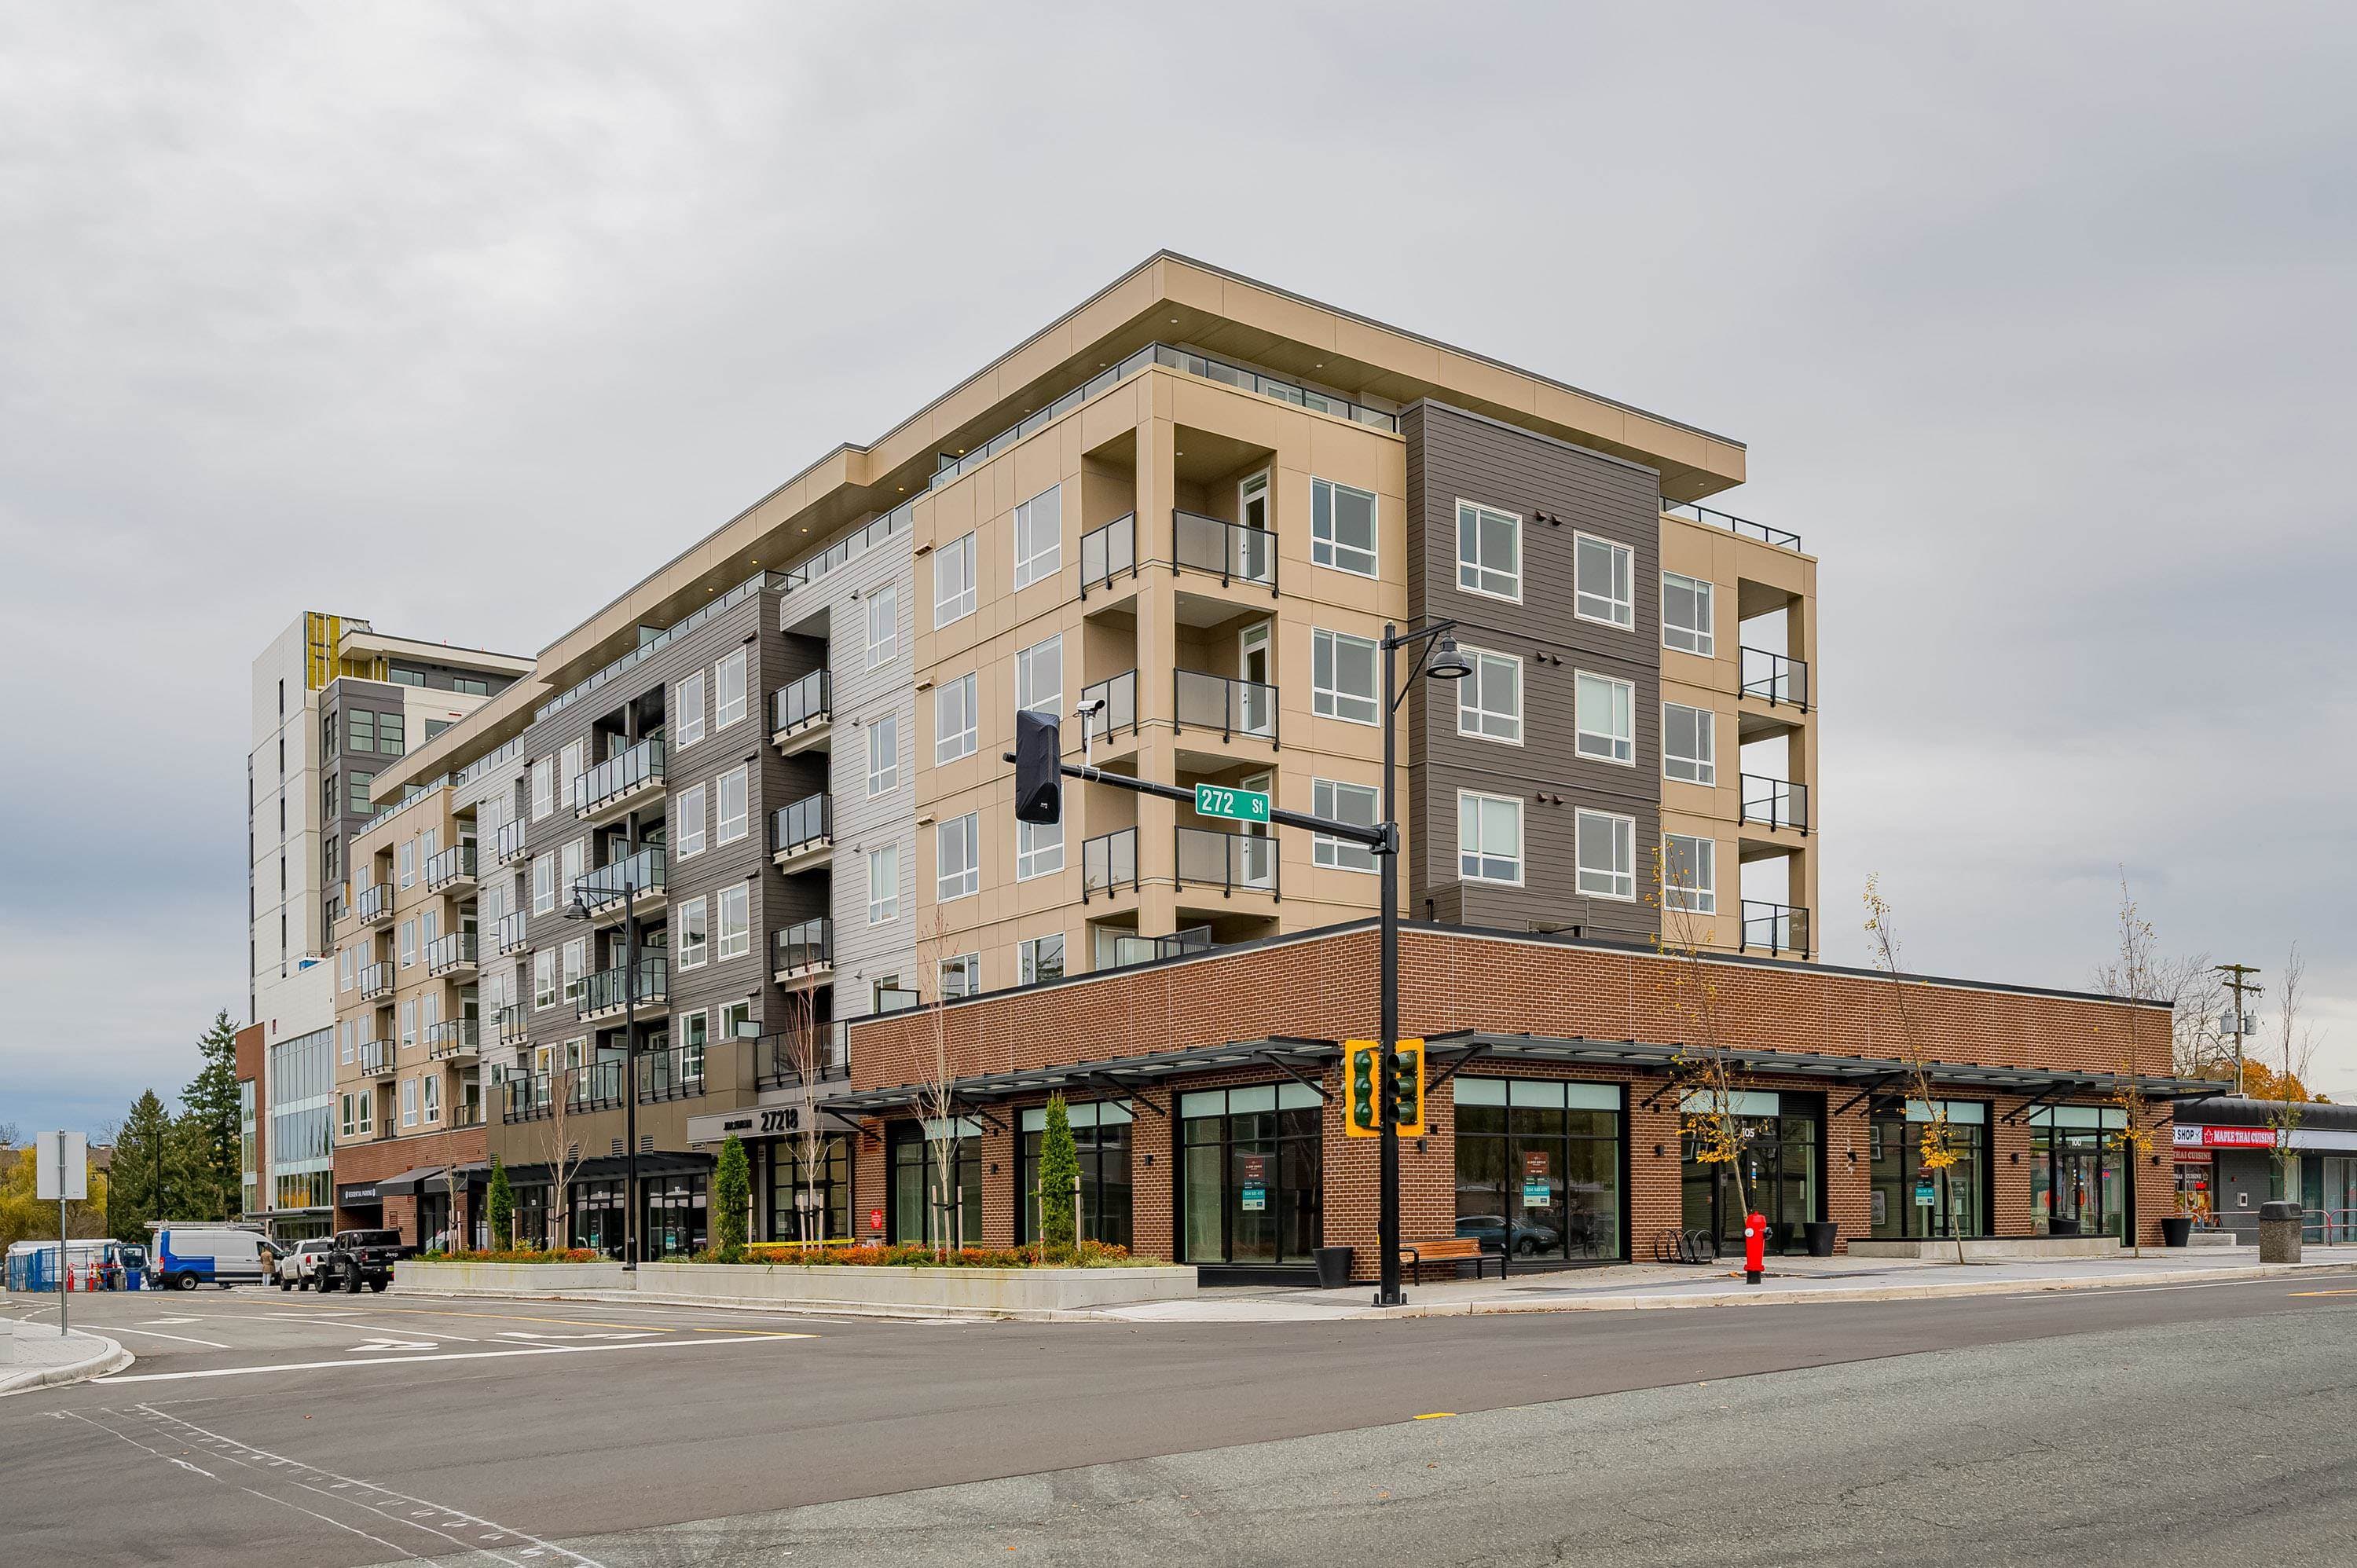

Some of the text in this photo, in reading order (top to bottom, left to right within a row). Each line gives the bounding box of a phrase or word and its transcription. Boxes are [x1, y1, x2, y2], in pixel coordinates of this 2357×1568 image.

[1202, 789, 1263, 814] 272 St
[761, 1108, 798, 1131] 27218
[1742, 1128, 1754, 1138] 105
[2177, 1129, 2194, 1141] SHOP
[2213, 1130, 2275, 1145] MAPLE THAI CUISINE
[2187, 1152, 2212, 1160] CUISINE
